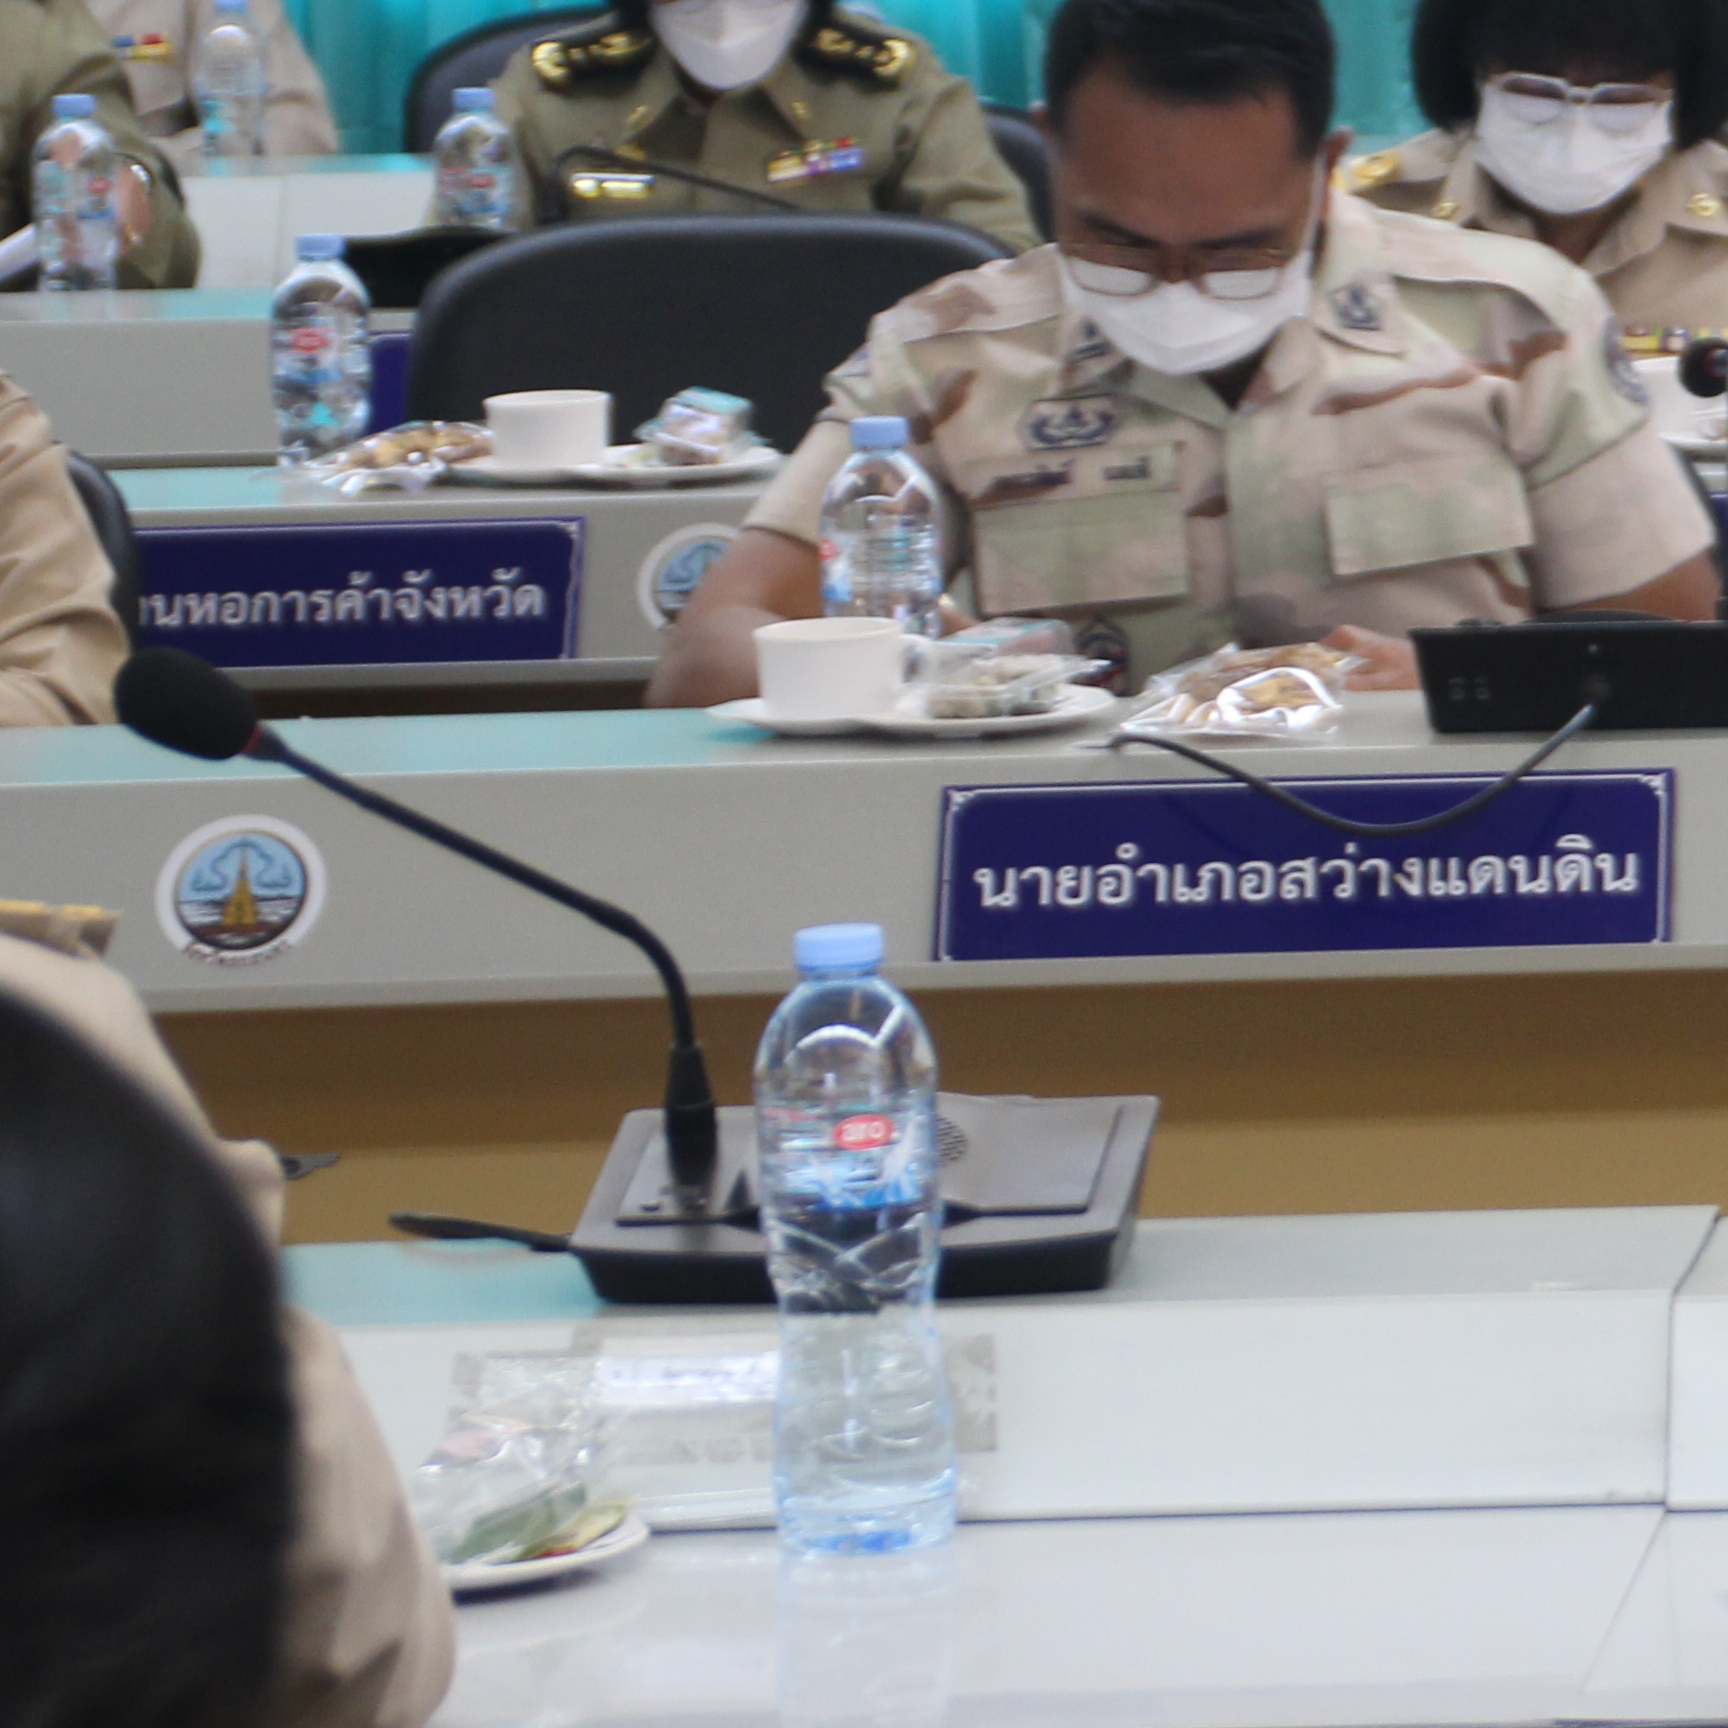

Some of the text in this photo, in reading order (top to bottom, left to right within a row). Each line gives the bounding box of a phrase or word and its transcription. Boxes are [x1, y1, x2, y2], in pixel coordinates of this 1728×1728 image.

[973, 833, 1640, 909] นายอำเภอสว่างแดนดิน
